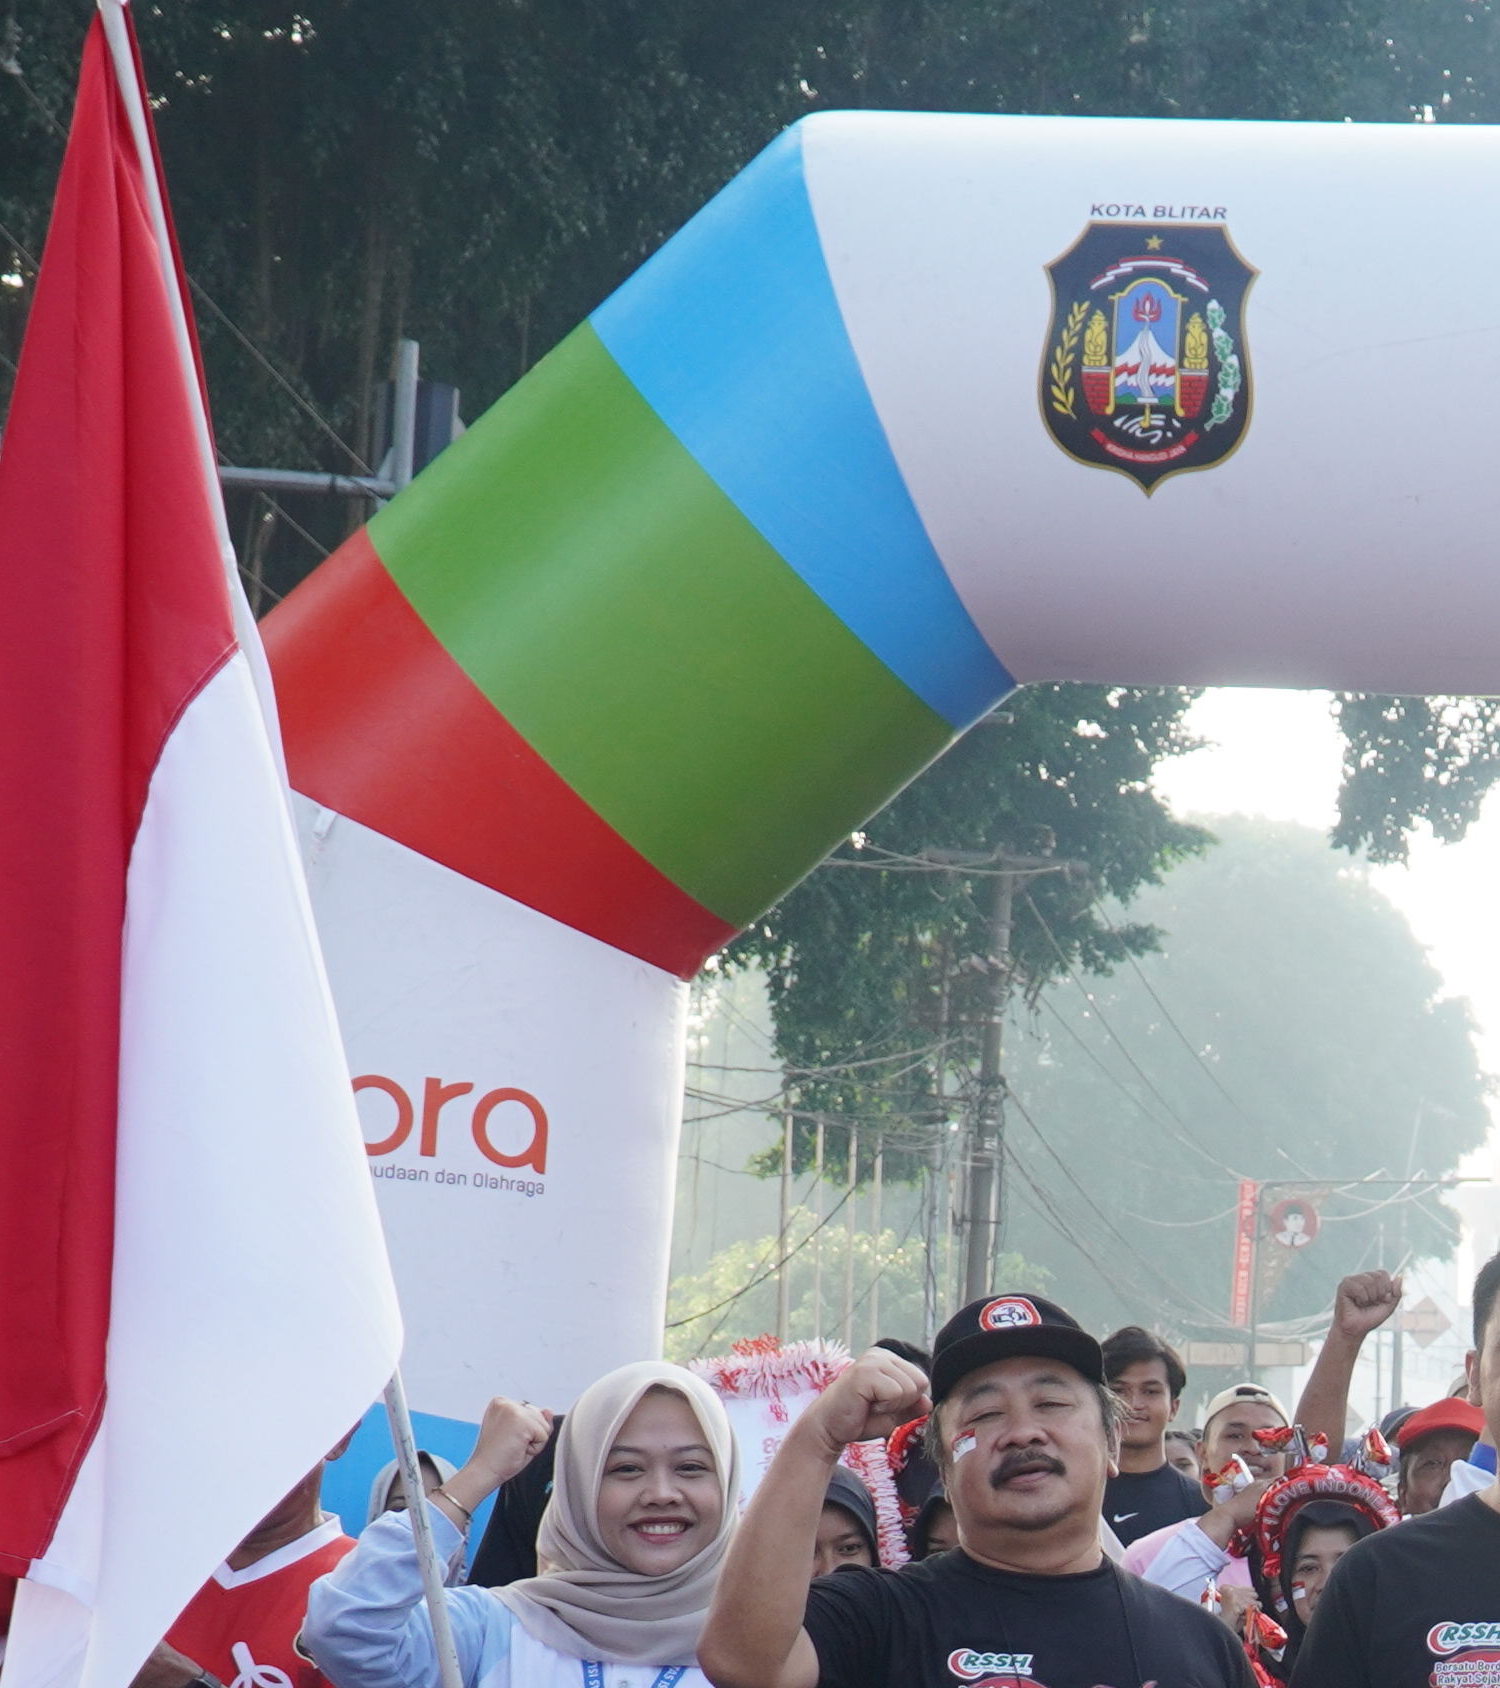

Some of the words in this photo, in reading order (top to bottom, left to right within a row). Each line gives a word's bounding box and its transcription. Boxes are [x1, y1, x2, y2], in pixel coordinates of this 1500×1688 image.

[1090, 203, 1147, 218] KOTA
[1153, 204, 1228, 220] BLITAR
[368, 1164, 430, 1184] udaan
[434, 1168, 468, 1187] dan
[472, 1172, 546, 1198] Olahraga
[1265, 1480, 1311, 1517] LOVE
[963, 1653, 1030, 1668] RSSH
[1435, 1660, 1476, 1673] Bersatu
[1437, 1674, 1476, 1687] Rakyat
